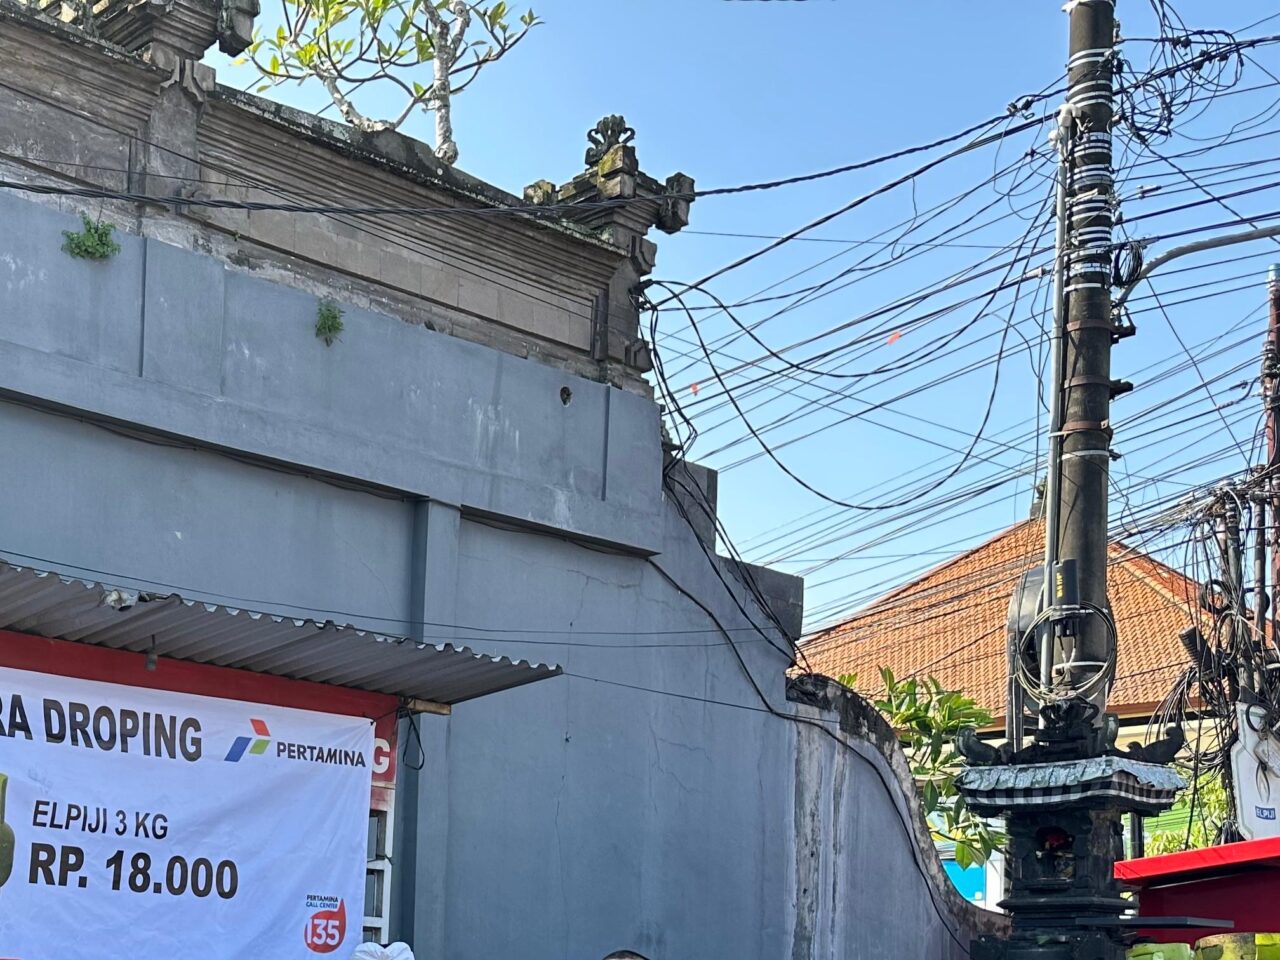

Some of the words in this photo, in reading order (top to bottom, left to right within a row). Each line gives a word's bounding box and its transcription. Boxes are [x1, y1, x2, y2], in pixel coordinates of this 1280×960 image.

[43, 698, 202, 762] DROPING
[277, 742, 366, 768] PERTAMINA
[32, 800, 107, 834] ELPIJI
[115, 810, 127, 836] 3
[134, 812, 168, 839] KG
[28, 842, 88, 888] RP.
[106, 850, 239, 899] 18.000
[306, 894, 339, 903] PERTAMINA
[306, 918, 340, 946] 135
